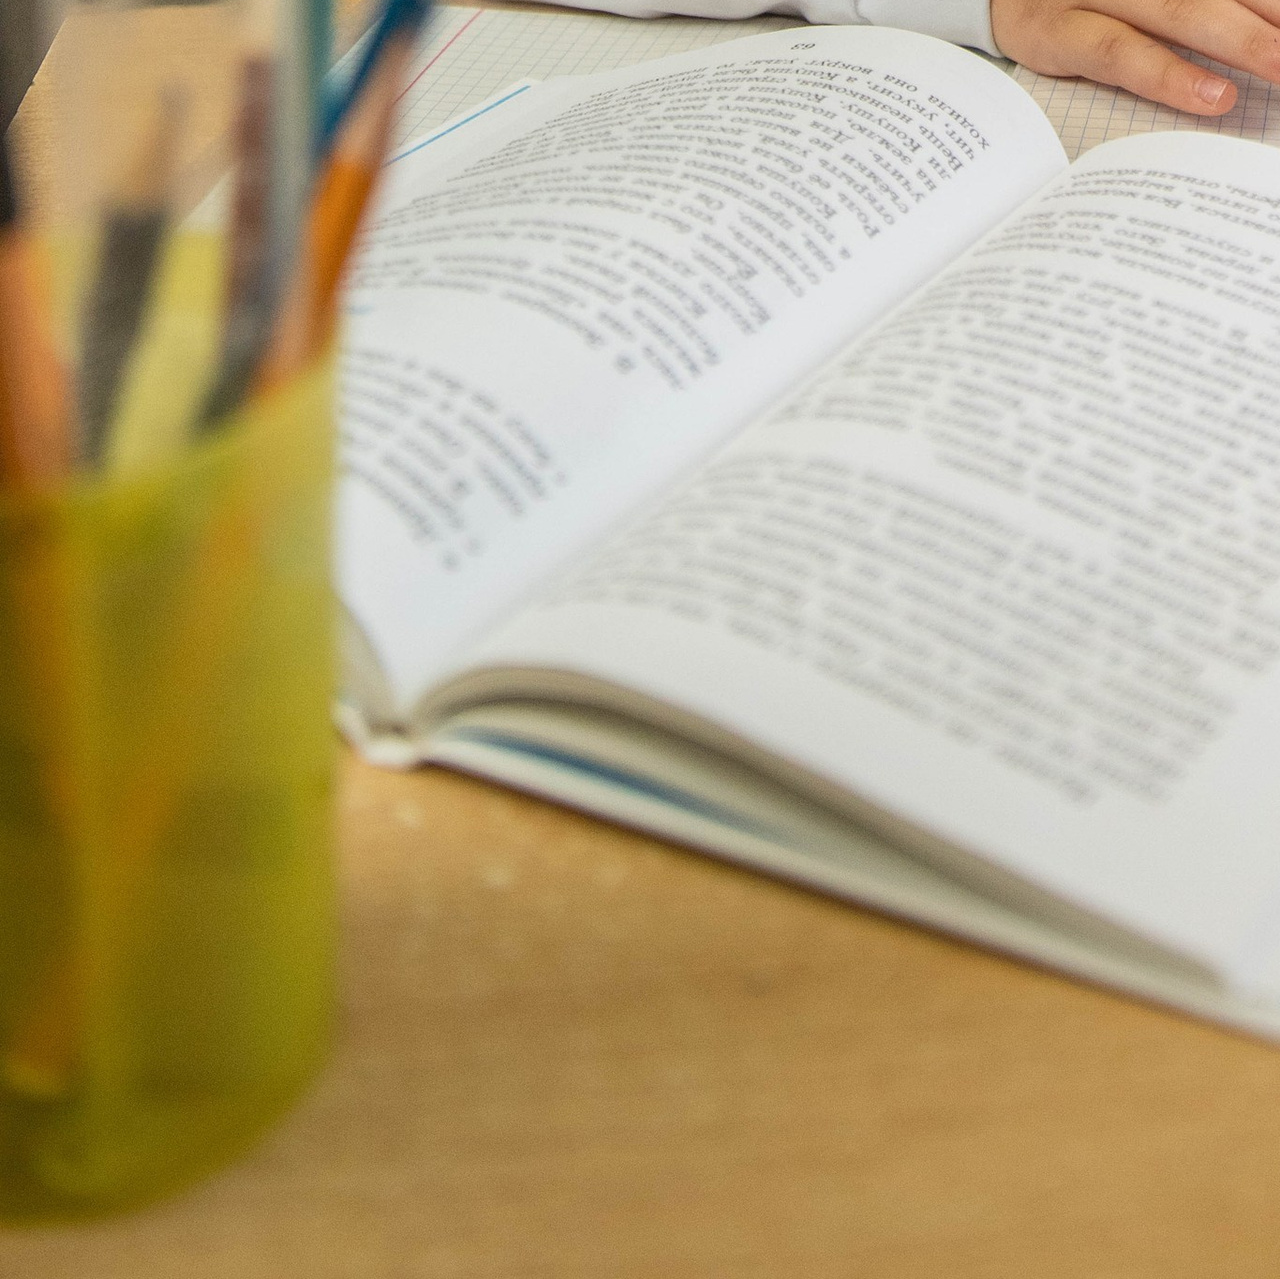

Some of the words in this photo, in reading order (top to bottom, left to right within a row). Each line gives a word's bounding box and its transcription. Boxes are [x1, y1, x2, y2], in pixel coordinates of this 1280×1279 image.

[763, 67, 840, 81] Копуша
[804, 59, 874, 75] вокруг
[883, 74, 918, 92] она
[796, 78, 913, 124] незнакомая,
[866, 72, 939, 121] укусит,
[808, 137, 835, 152] не
[809, 120, 855, 144] Для
[840, 100, 922, 153] Копушу.
[846, 118, 912, 165] землю,
[927, 94, 990, 150] ходила
[944, 122, 975, 161] чит,
[918, 125, 964, 172] Вещь
[927, 156, 951, 179] ли
[756, 164, 837, 220] Копуша
[808, 173, 832, 190] её
[818, 158, 895, 225] открыть
[840, 153, 909, 214] съёмки
[868, 148, 925, 203] учить.
[916, 167, 937, 192] на
[769, 190, 835, 244] только
[837, 191, 881, 239] Роль
